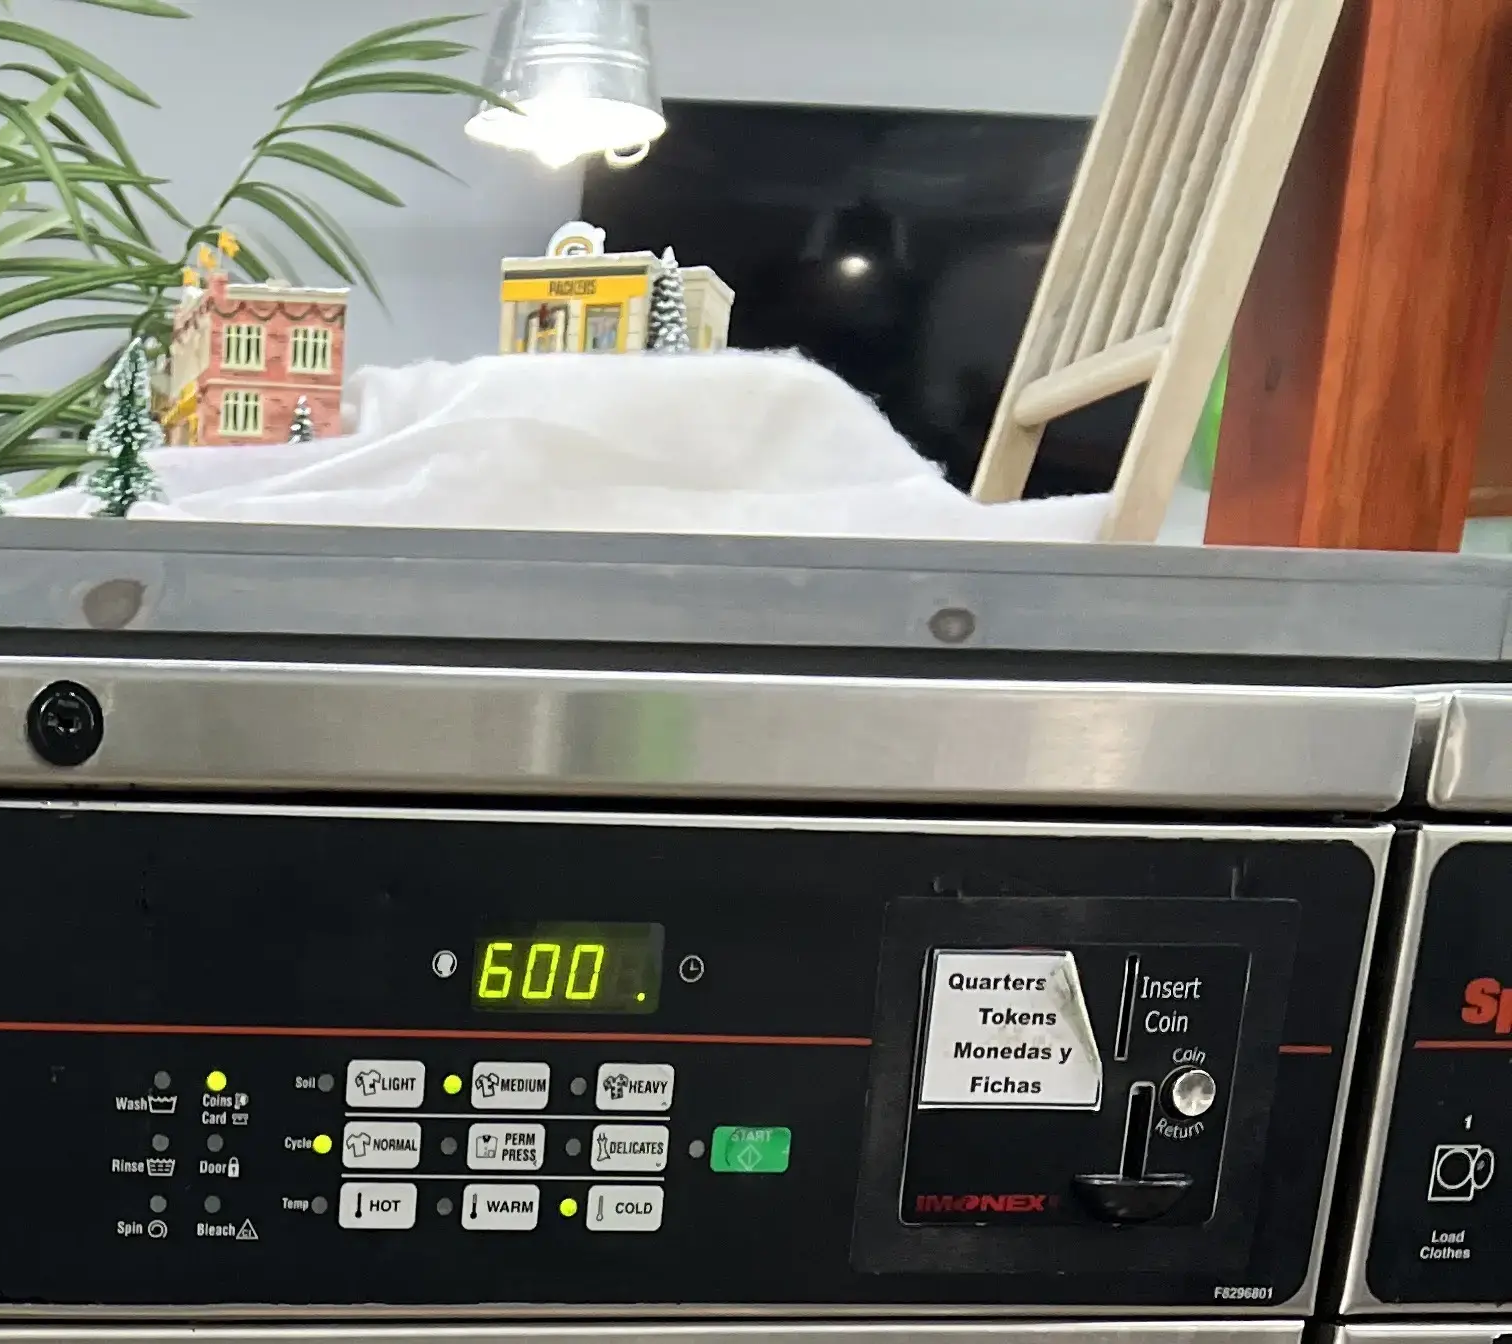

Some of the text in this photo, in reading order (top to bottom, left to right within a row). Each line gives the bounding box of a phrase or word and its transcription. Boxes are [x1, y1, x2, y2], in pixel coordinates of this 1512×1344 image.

[948, 973, 1047, 994] Quarters
[1140, 977, 1202, 1000] Insert
[979, 1008, 1057, 1026] Tokens
[1145, 1011, 1188, 1034] Coin
[953, 1043, 1072, 1063] Monedas y
[1172, 1047, 1206, 1064] Coin
[295, 1075, 315, 1089] Soil
[381, 1077, 416, 1093] LIGHT
[500, 1078, 546, 1094] MEDIUM
[629, 1080, 667, 1096] HEAVY
[970, 1076, 1042, 1095] Fichas
[116, 1096, 148, 1113] Wash
[202, 1093, 233, 1110] Coins
[201, 1111, 227, 1126] Card
[1463, 1115, 1473, 1129] 1
[732, 1130, 772, 1142] START
[1155, 1119, 1204, 1140] Return
[284, 1135, 313, 1152] Cycle
[373, 1137, 417, 1152] NORMAL
[504, 1133, 536, 1147] PERM
[502, 1148, 537, 1162] PRESS
[609, 1141, 664, 1156] DELICATES
[111, 1158, 145, 1175] Rinse
[199, 1159, 227, 1175] Door
[282, 1196, 309, 1213] Temp
[369, 1198, 400, 1213] HOT
[486, 1199, 533, 1215] WARM
[615, 1201, 653, 1216] COLD
[916, 1195, 1046, 1212] IMONEX
[117, 1220, 143, 1237] Spin
[196, 1222, 236, 1239] Bleach
[1431, 1231, 1466, 1244] Load
[1419, 1245, 1470, 1260] Clothes
